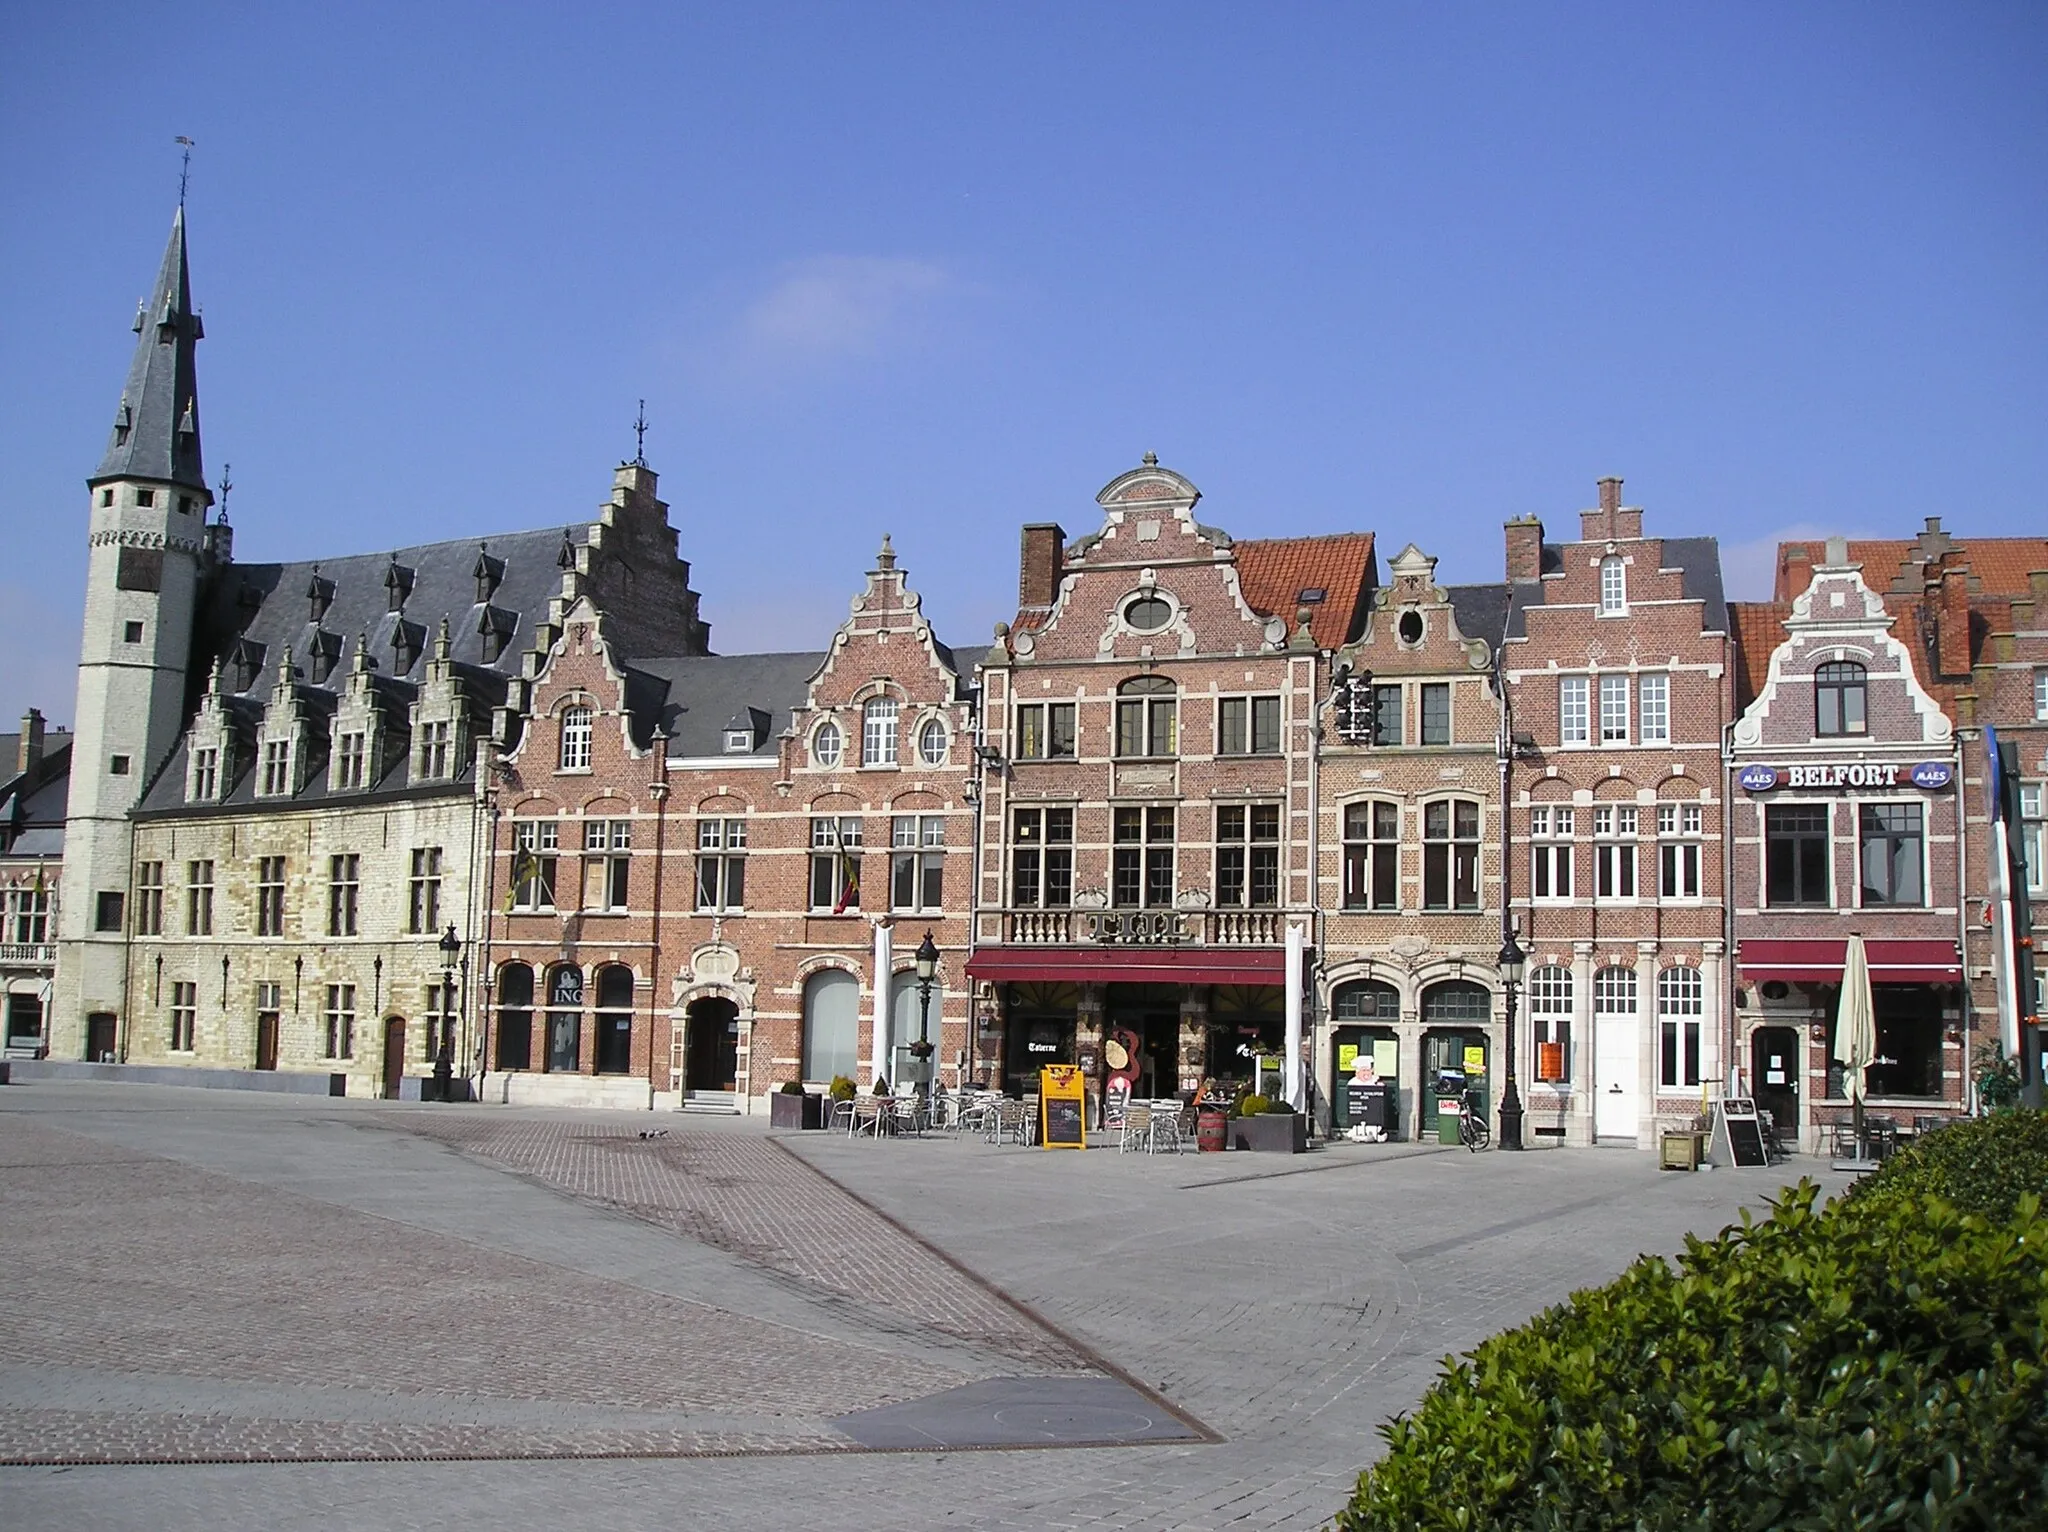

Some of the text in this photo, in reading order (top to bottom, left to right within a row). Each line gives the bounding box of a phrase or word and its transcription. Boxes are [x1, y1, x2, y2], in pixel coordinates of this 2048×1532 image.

[1743, 774, 1772, 784] MAES
[1788, 764, 1899, 787] BELFORT
[1916, 771, 1946, 781] MAES
[1085, 911, 1192, 940] TIJL
[555, 989, 583, 1003] ING
